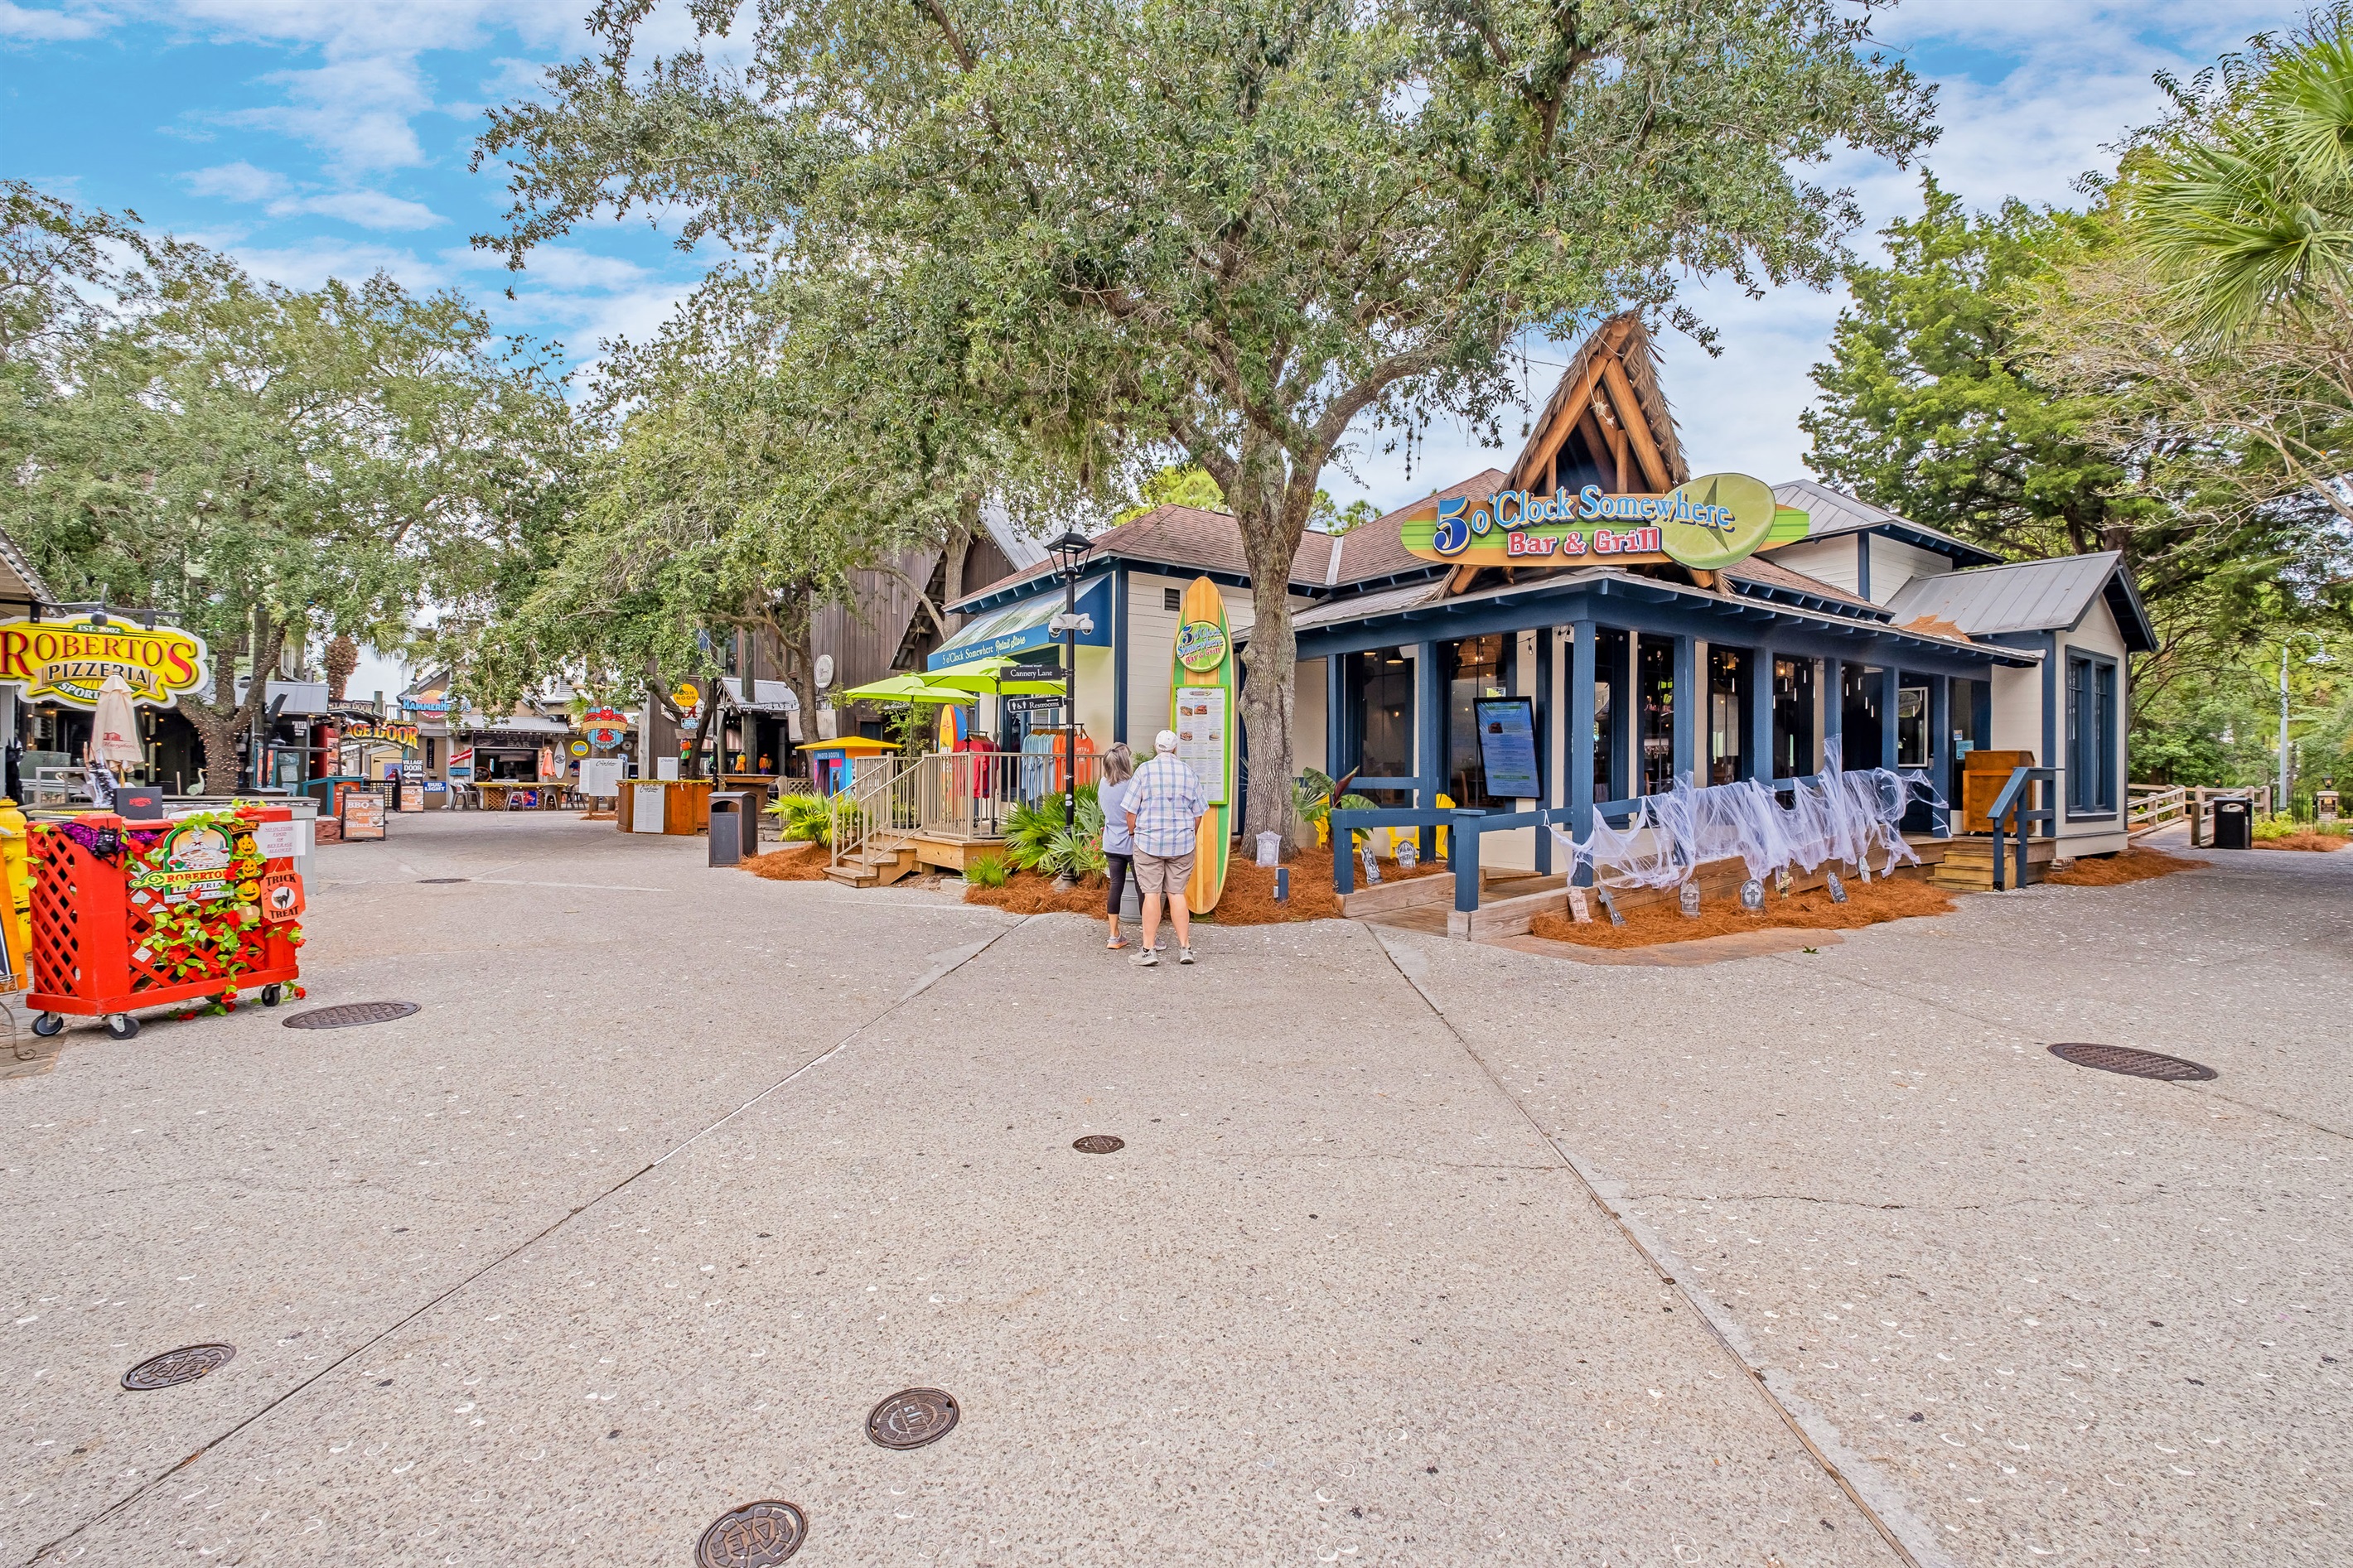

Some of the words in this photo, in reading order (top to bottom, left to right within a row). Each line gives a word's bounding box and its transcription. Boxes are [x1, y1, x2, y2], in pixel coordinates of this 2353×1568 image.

[1433, 495, 1471, 557] 5
[1578, 484, 1735, 533] Somewhere
[1508, 531, 1560, 557] Bar
[1563, 531, 1589, 556] &
[1594, 526, 1662, 555] Grill
[78, 625, 97, 633] EST.
[99, 625, 121, 634] 2002
[1182, 625, 1194, 645] 5
[0, 630, 192, 684] ROBERTO'S
[942, 655, 946, 664] 5
[946, 650, 964, 663] o'Clock
[965, 644, 993, 660] Somewhere
[994, 638, 1010, 654] Retail
[1010, 635, 1026, 650] Store
[1177, 638, 1224, 658] Somewhere
[1186, 654, 1198, 665] Bar
[1205, 647, 1220, 656] Grill
[48, 663, 147, 684] PIZZERIA
[1010, 668, 1036, 678] Cannery
[1037, 668, 1053, 677] Lane
[57, 681, 99, 700] SPORT
[328, 702, 351, 711] ILLAGE
[352, 703, 374, 714] DOOR
[265, 873, 297, 886] TRICK
[269, 905, 299, 919] TREAT
[710, 1517, 793, 1559] WATER
